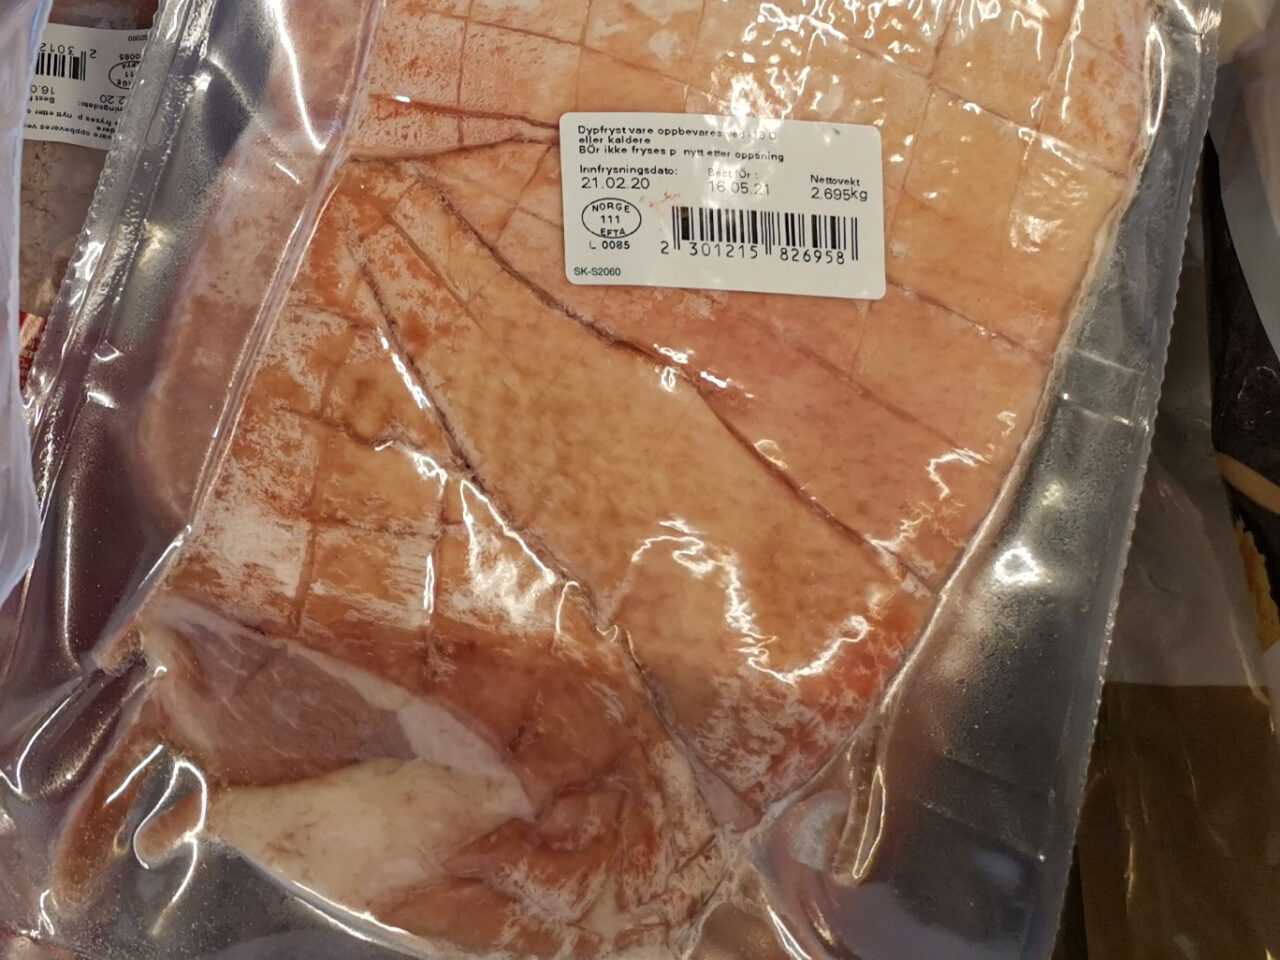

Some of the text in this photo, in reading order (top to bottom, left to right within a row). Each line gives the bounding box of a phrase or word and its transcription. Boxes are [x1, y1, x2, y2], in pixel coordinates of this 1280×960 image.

[90, 49, 97, 58] 2
[57, 110, 72, 118] nytt
[578, 125, 626, 135] Dypfryst
[658, 127, 722, 136] oppbevares
[579, 136, 651, 144] eller kaldere
[604, 145, 627, 154] ikke
[632, 146, 666, 156] fryses
[684, 149, 704, 157] nytt
[580, 164, 677, 175] Innfrysningsdato:
[581, 177, 650, 189] 21.02.20
[810, 174, 860, 186] Nettovekt
[710, 181, 769, 195] 16.05.21
[811, 187, 868, 202] 2.695kg
[592, 202, 630, 213] NORGE
[601, 215, 620, 223] 111
[601, 228, 626, 236] EFTA
[589, 241, 630, 249] L 0085
[661, 241, 844, 264] 2 301215 826958
[574, 267, 621, 276] SK-S2060
